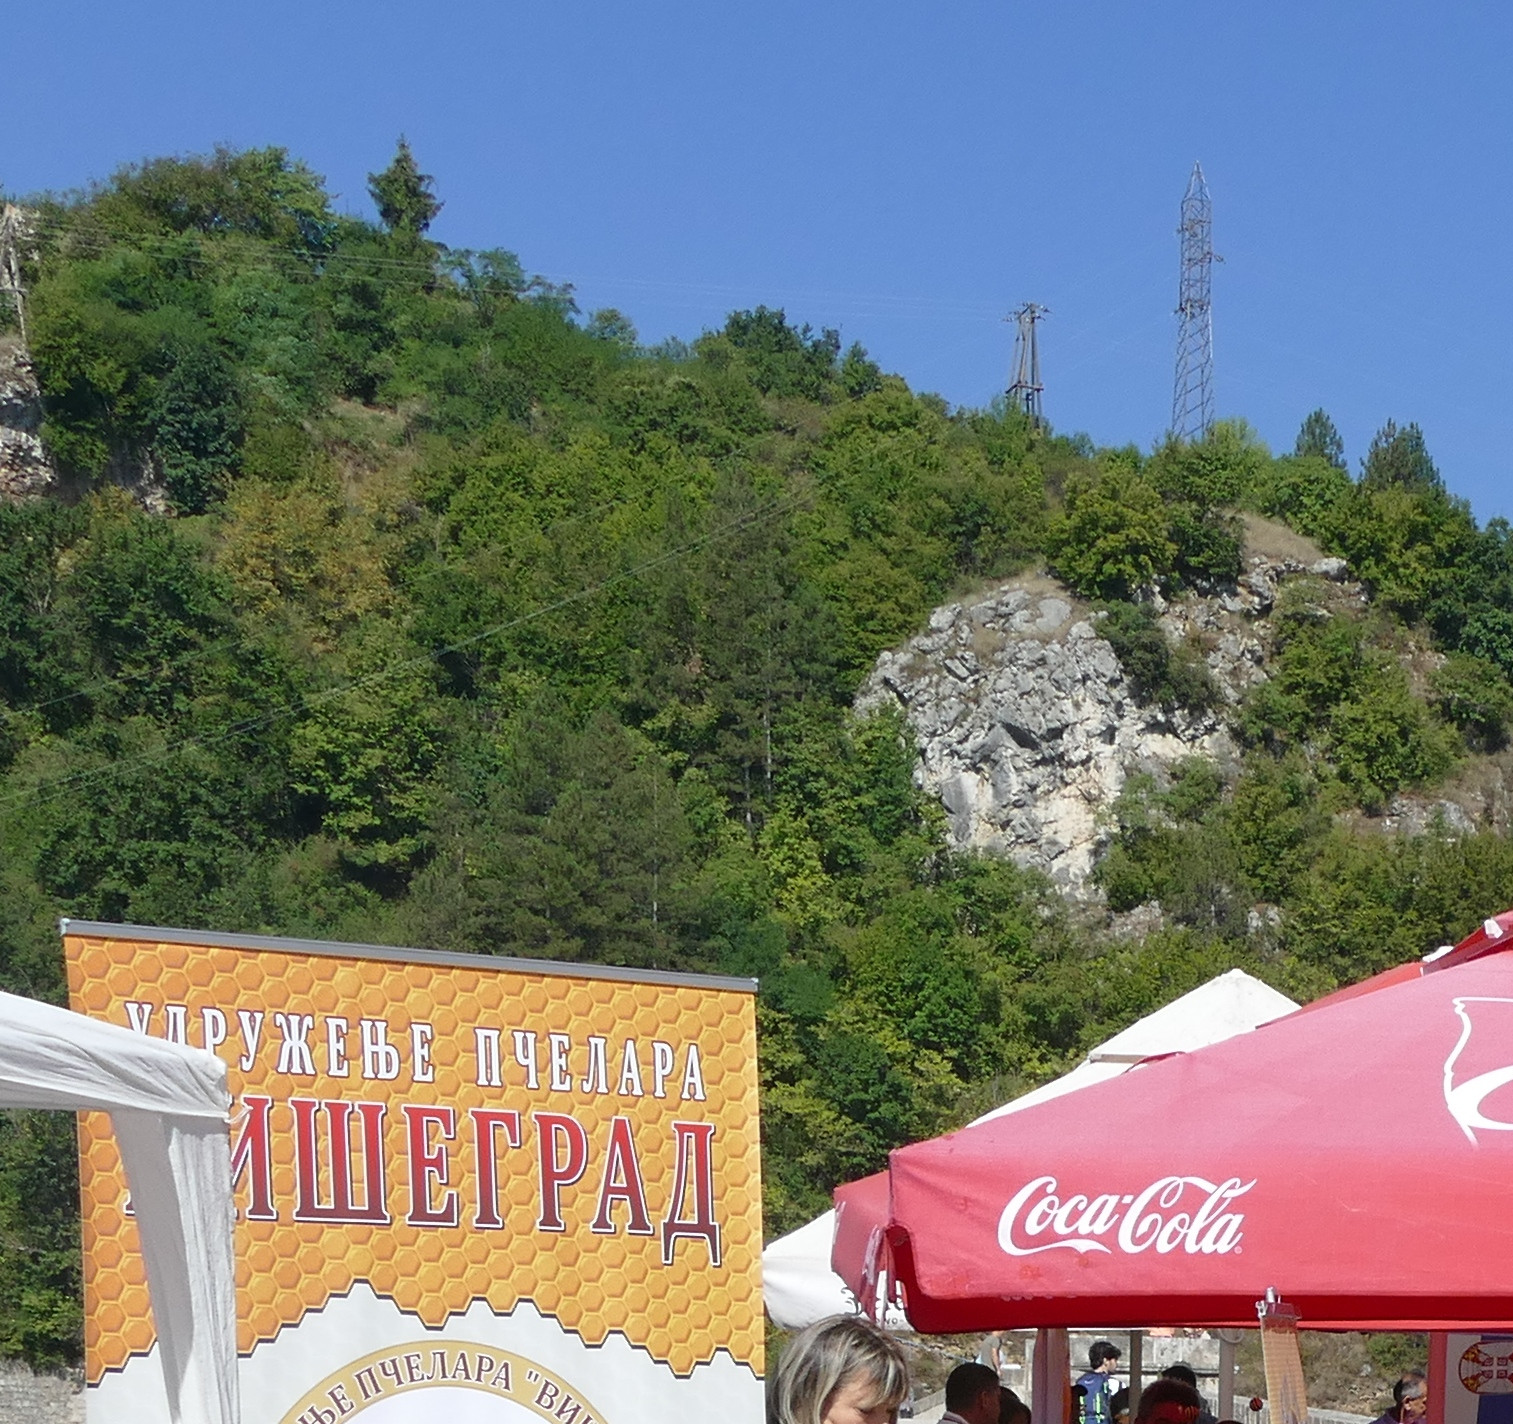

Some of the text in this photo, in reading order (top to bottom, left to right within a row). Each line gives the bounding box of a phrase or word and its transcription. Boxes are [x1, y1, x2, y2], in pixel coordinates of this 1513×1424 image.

[474, 1027, 706, 1101] ПЧЕЛАРА
[122, 1094, 722, 1267] ИШЕГРАД
[997, 1175, 1257, 1256] Coca-Cola
[353, 1350, 513, 1400] ПЧЕЛАРА
